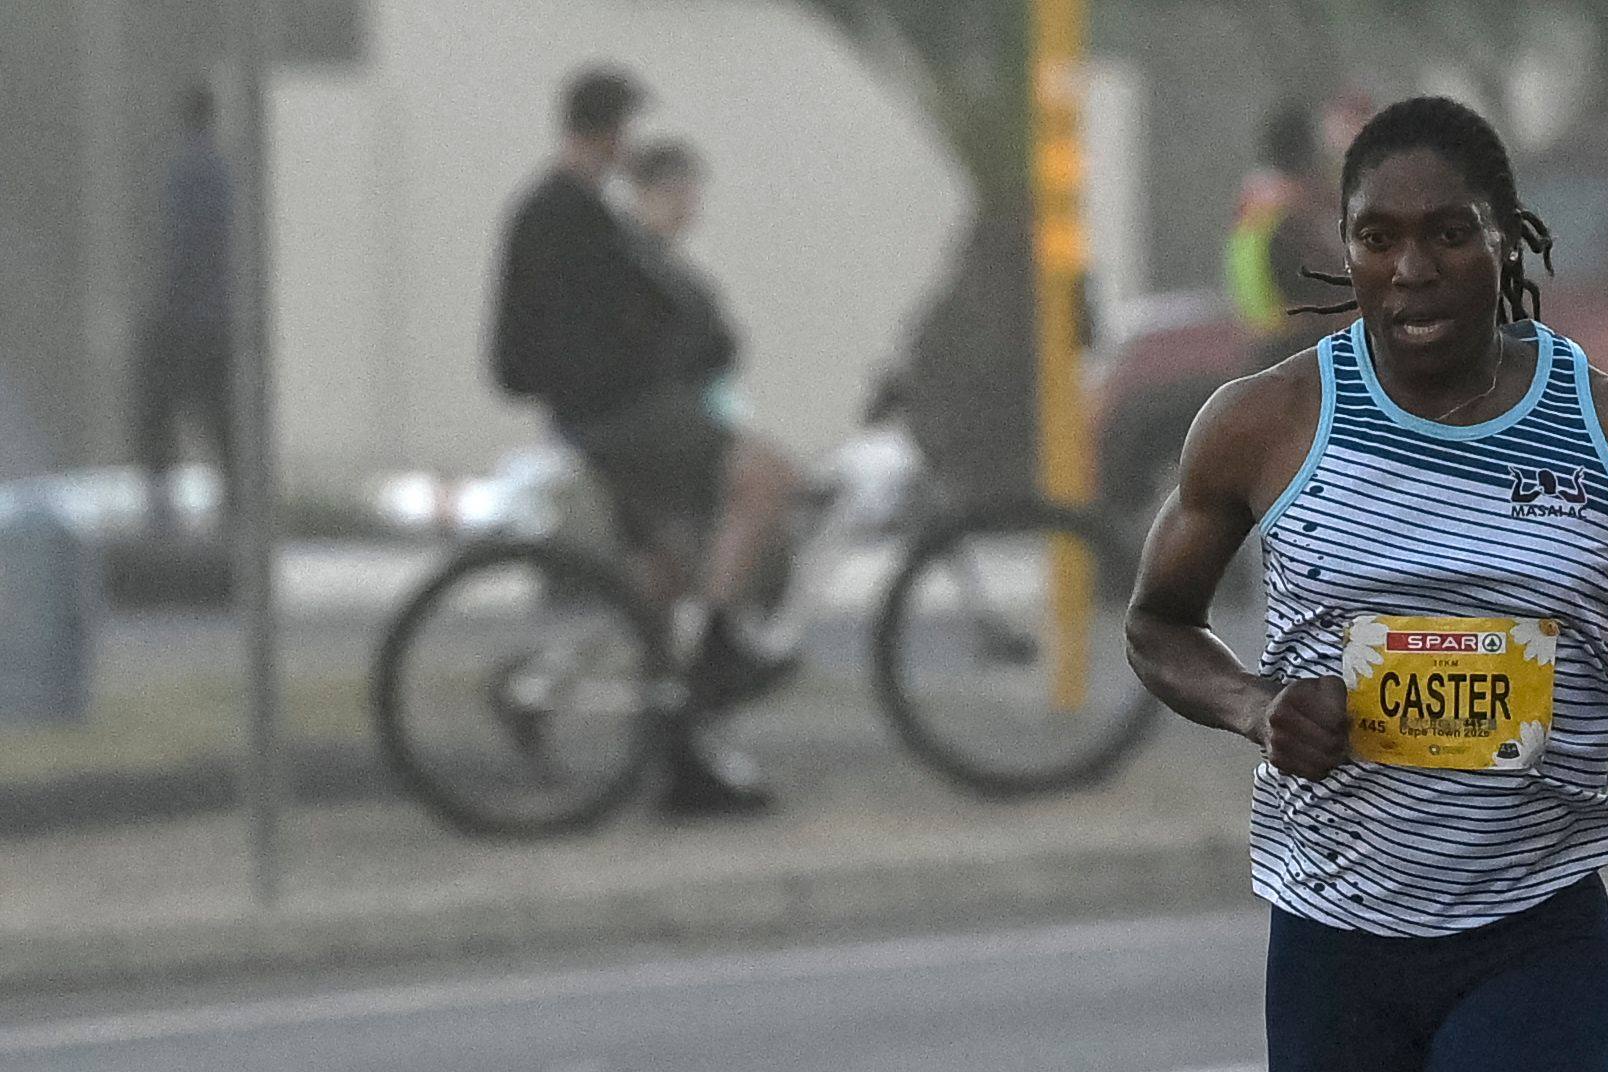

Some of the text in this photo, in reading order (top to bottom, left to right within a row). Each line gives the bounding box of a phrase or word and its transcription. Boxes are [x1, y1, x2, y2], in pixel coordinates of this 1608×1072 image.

[1407, 635, 1477, 650] SPAR
[1380, 672, 1511, 720] CASTER
[1358, 719, 1386, 734] 445
[1400, 727, 1428, 738] Cape
[1430, 727, 1461, 737] Town
[562, 745, 608, 777] TDA
